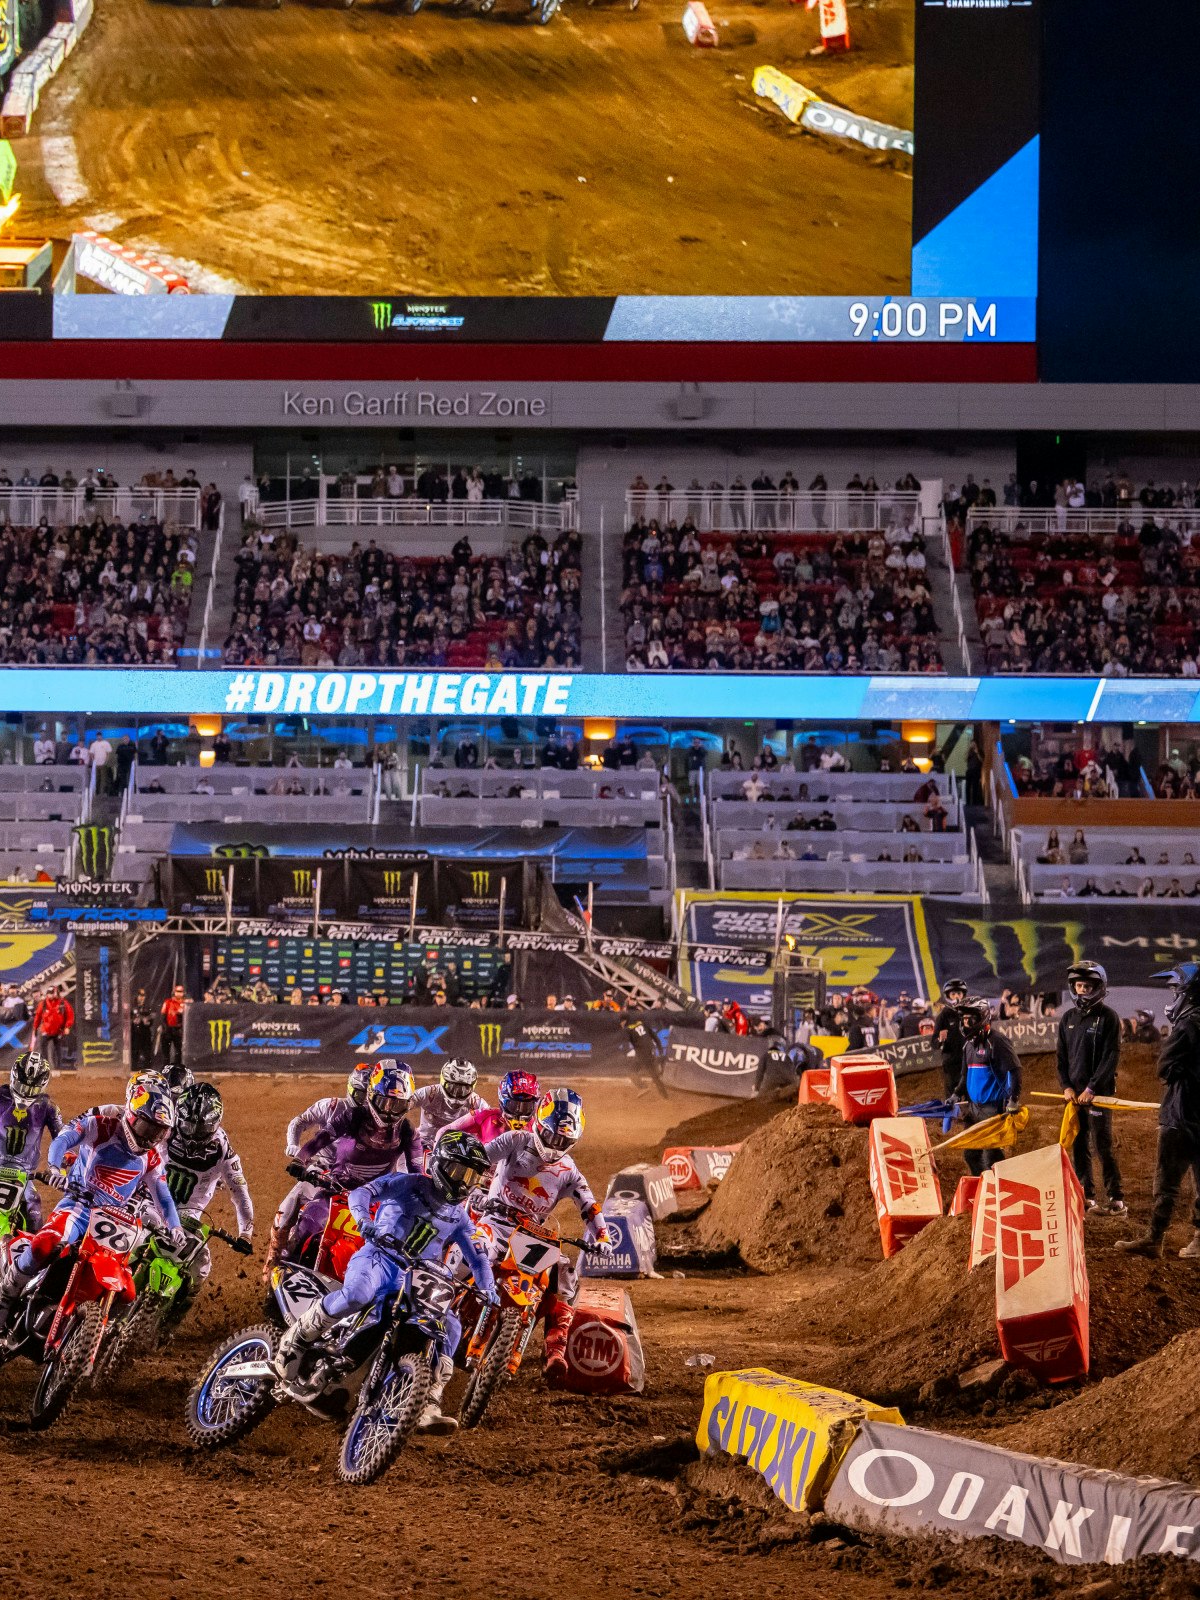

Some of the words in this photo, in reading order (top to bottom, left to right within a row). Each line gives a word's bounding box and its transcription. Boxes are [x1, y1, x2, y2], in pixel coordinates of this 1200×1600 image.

[849, 302, 927, 337] 9:00
[939, 303, 997, 337] PM
[284, 391, 334, 415] Ken
[344, 391, 407, 416] Garff
[417, 392, 470, 416] Red
[479, 392, 546, 416] Zone
[225, 673, 573, 716] #DROPTHEGATE
[58, 882, 132, 895] MONSTER
[66, 921, 129, 931] Championship
[251, 1022, 301, 1032] MONSTER
[522, 1026, 571, 1036] MONSTER
[999, 1022, 1058, 1039] MONST
[672, 1043, 760, 1069] TRIUMP
[669, 1164, 687, 1176] RM
[502, 1184, 526, 1207] Red
[525, 1199, 548, 1214] Bull
[94, 1220, 130, 1252] 96
[999, 1178, 1047, 1292] FLY
[1045, 1188, 1058, 1258] RACING
[519, 1243, 550, 1269] 1
[585, 1253, 632, 1266] YAMAHA
[413, 1272, 452, 1313] 32
[575, 1337, 614, 1357] RM
[706, 1394, 817, 1511] SUZUKI
